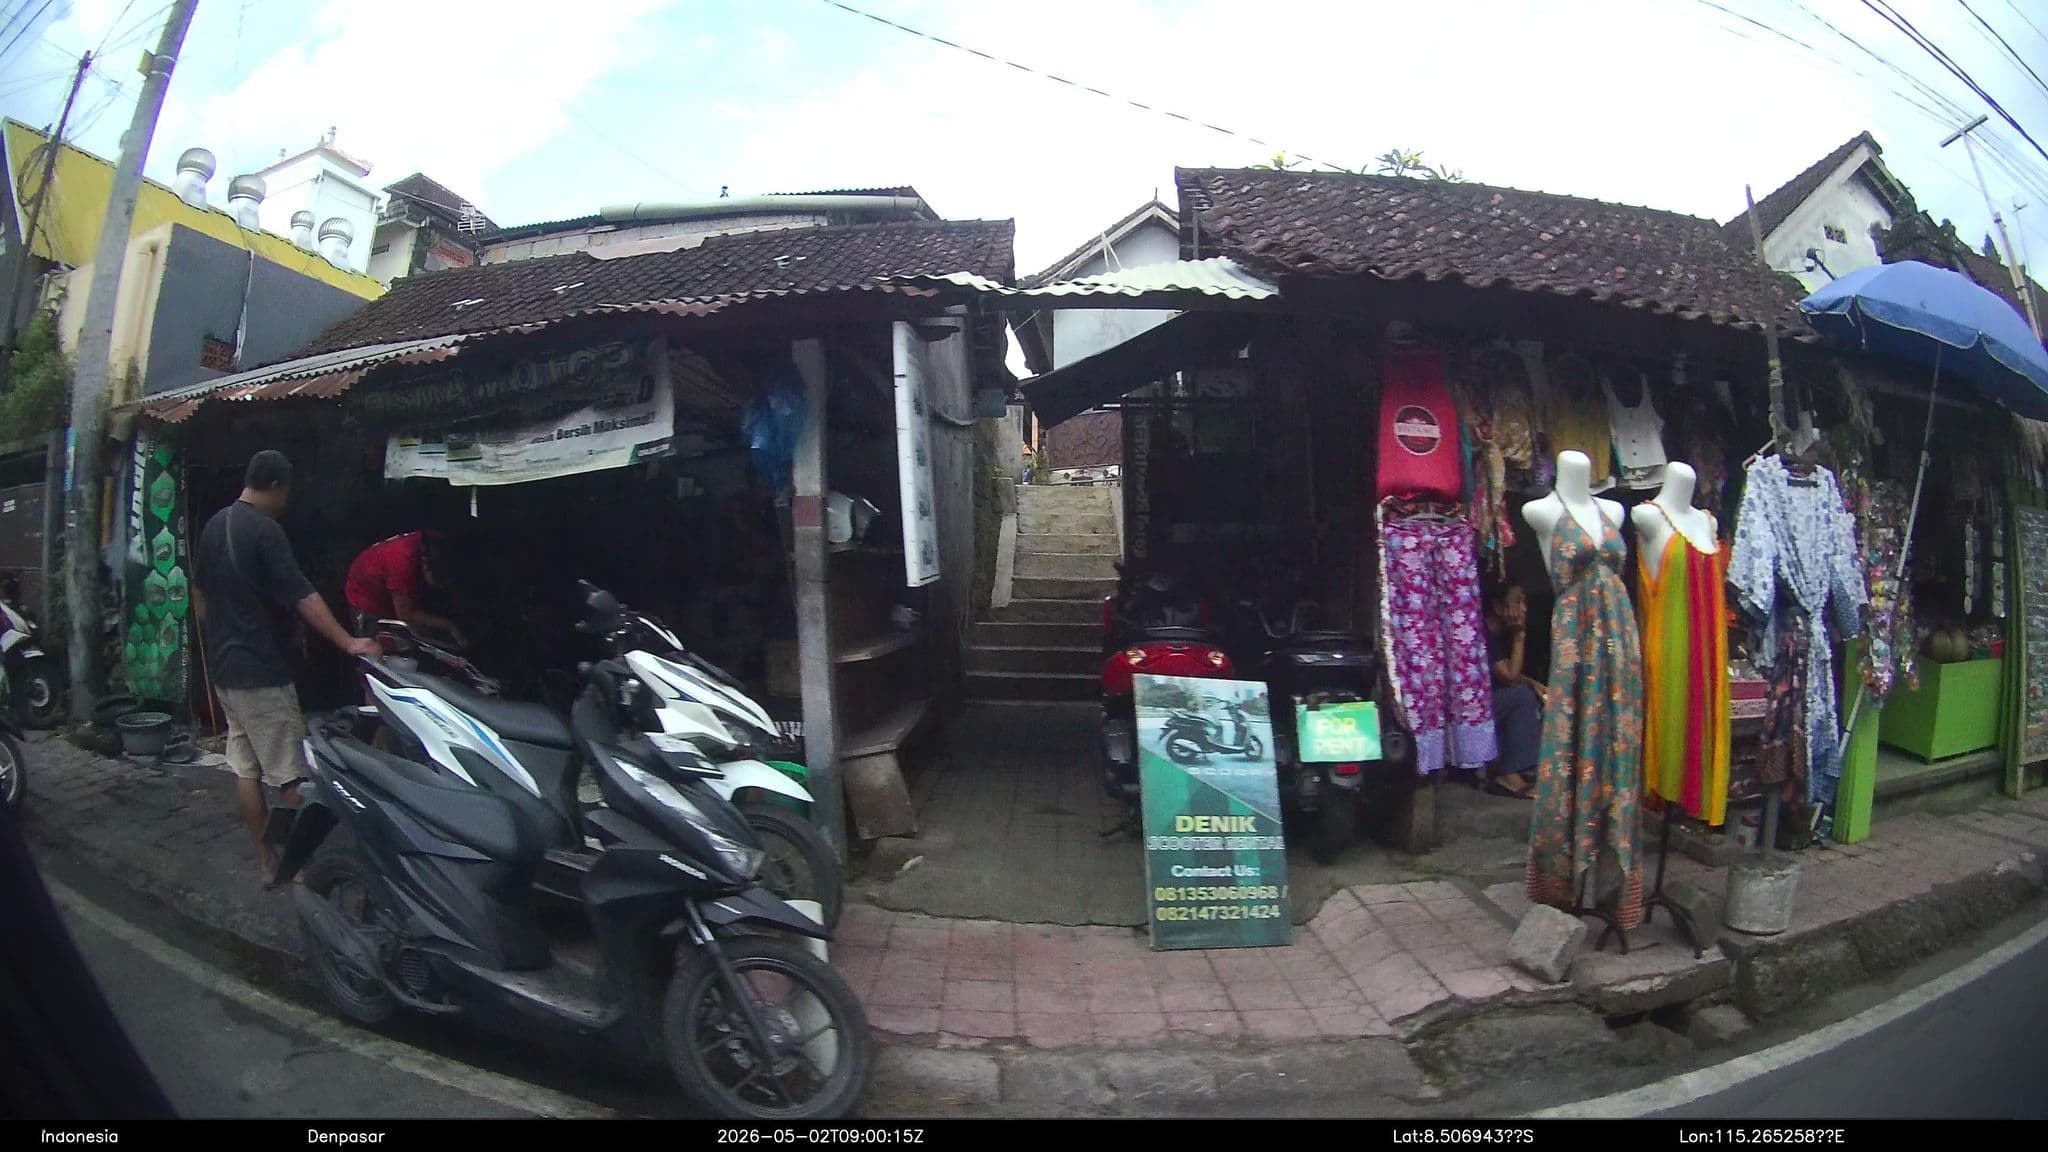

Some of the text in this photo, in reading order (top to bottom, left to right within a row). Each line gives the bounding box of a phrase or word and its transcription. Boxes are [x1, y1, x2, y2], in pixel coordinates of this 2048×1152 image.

[1174, 815, 1257, 833] DENIK
[1170, 864, 1260, 877] Contact Us:
